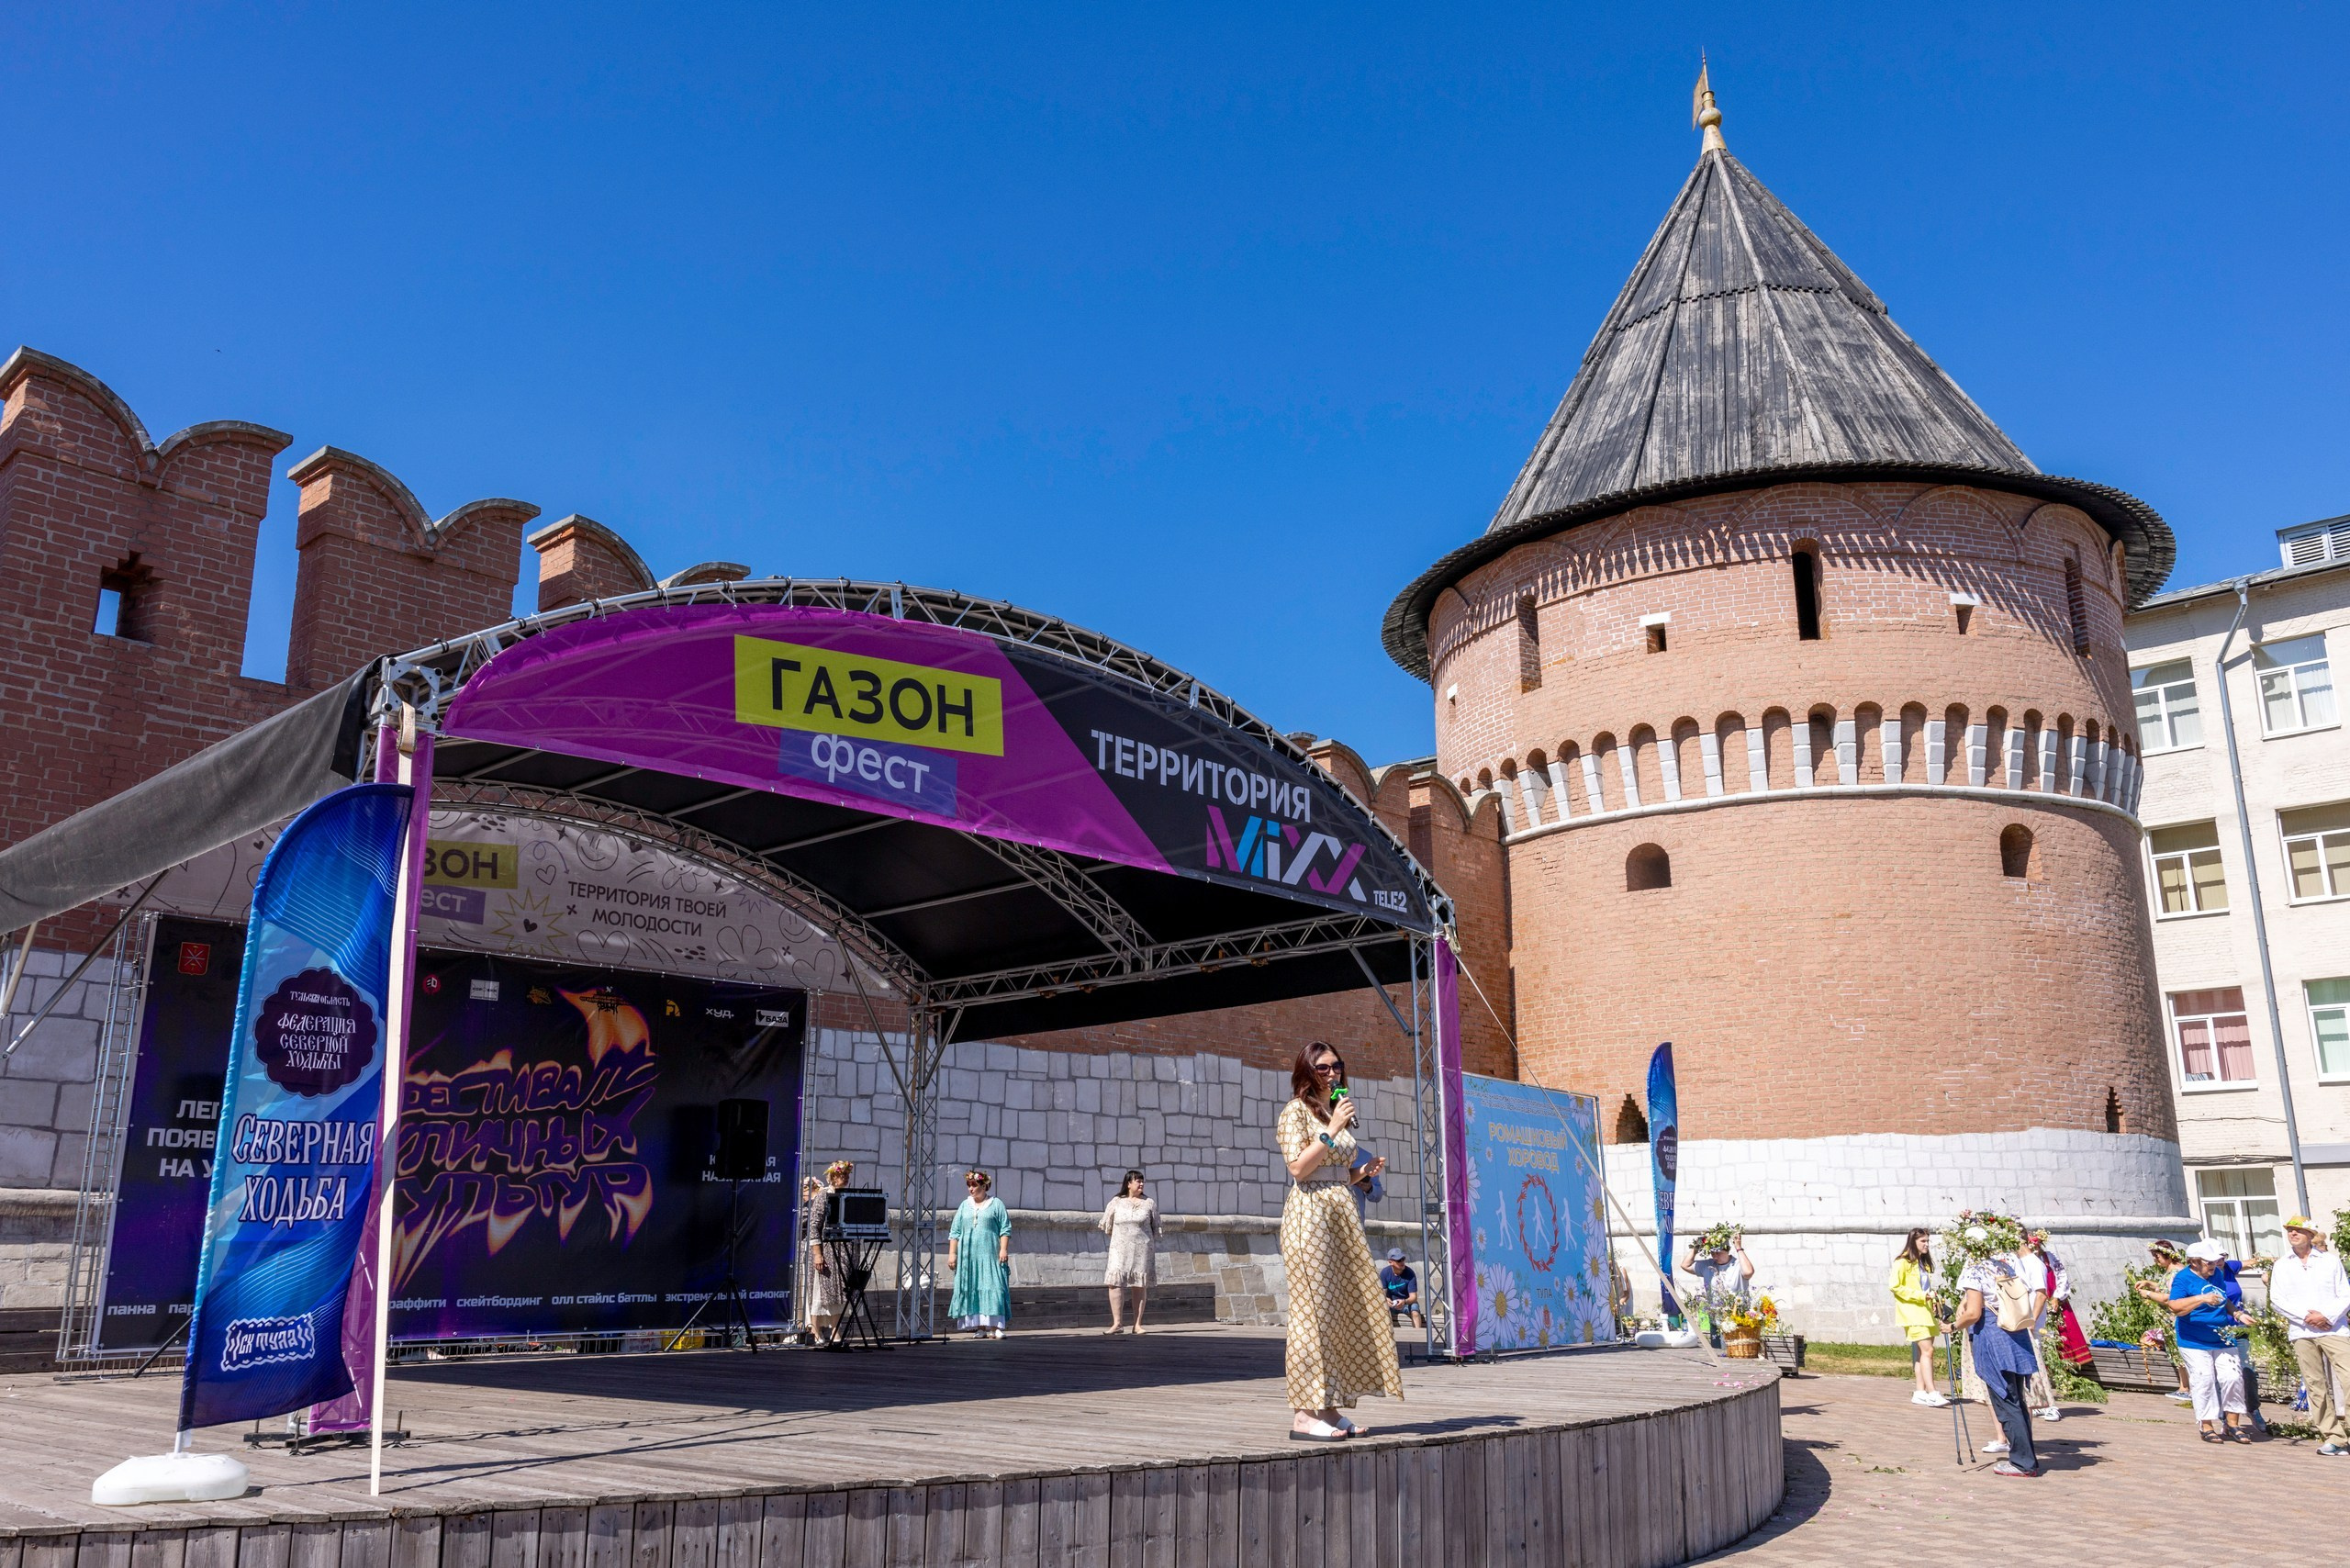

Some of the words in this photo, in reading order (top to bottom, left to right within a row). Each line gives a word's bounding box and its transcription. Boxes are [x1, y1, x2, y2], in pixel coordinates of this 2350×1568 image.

[770, 656, 975, 737] ГАЗОН
[811, 734, 930, 793] фест
[1091, 729, 1311, 823] ТЕРРИТОРИЯ
[424, 846, 498, 879] ЗОН
[421, 888, 466, 913] ест
[567, 880, 670, 911] ТЕРРИТОРИЯ
[675, 897, 727, 918] ТВОЕЙ
[1373, 890, 1408, 913] TELE2
[591, 908, 702, 936] МОЛОДОСТИ
[277, 1013, 356, 1036] ФЕДЕРАЦИЯ
[766, 1015, 789, 1025] БАЗА
[279, 1033, 349, 1054] СЕВЕРНОЙ
[285, 1050, 341, 1071] ХОДЬБЫ
[231, 1113, 376, 1165] СЕВЕРНАЯ
[1489, 1121, 1568, 1150] РОМАШКОВЫЙ
[159, 1159, 195, 1177] НА
[1506, 1147, 1560, 1174] ХОРОВОД
[239, 1175, 348, 1228] ХОДЬБА
[106, 1304, 156, 1316] панна
[168, 1304, 196, 1316] пар
[388, 1297, 447, 1311] раффити
[456, 1295, 543, 1307] скейтбординг
[551, 1295, 574, 1305] олл
[576, 1293, 615, 1304] стайлс
[618, 1292, 657, 1303] баттлы
[749, 1290, 789, 1300] самокат
[1536, 1287, 1553, 1299] ТУЛА
